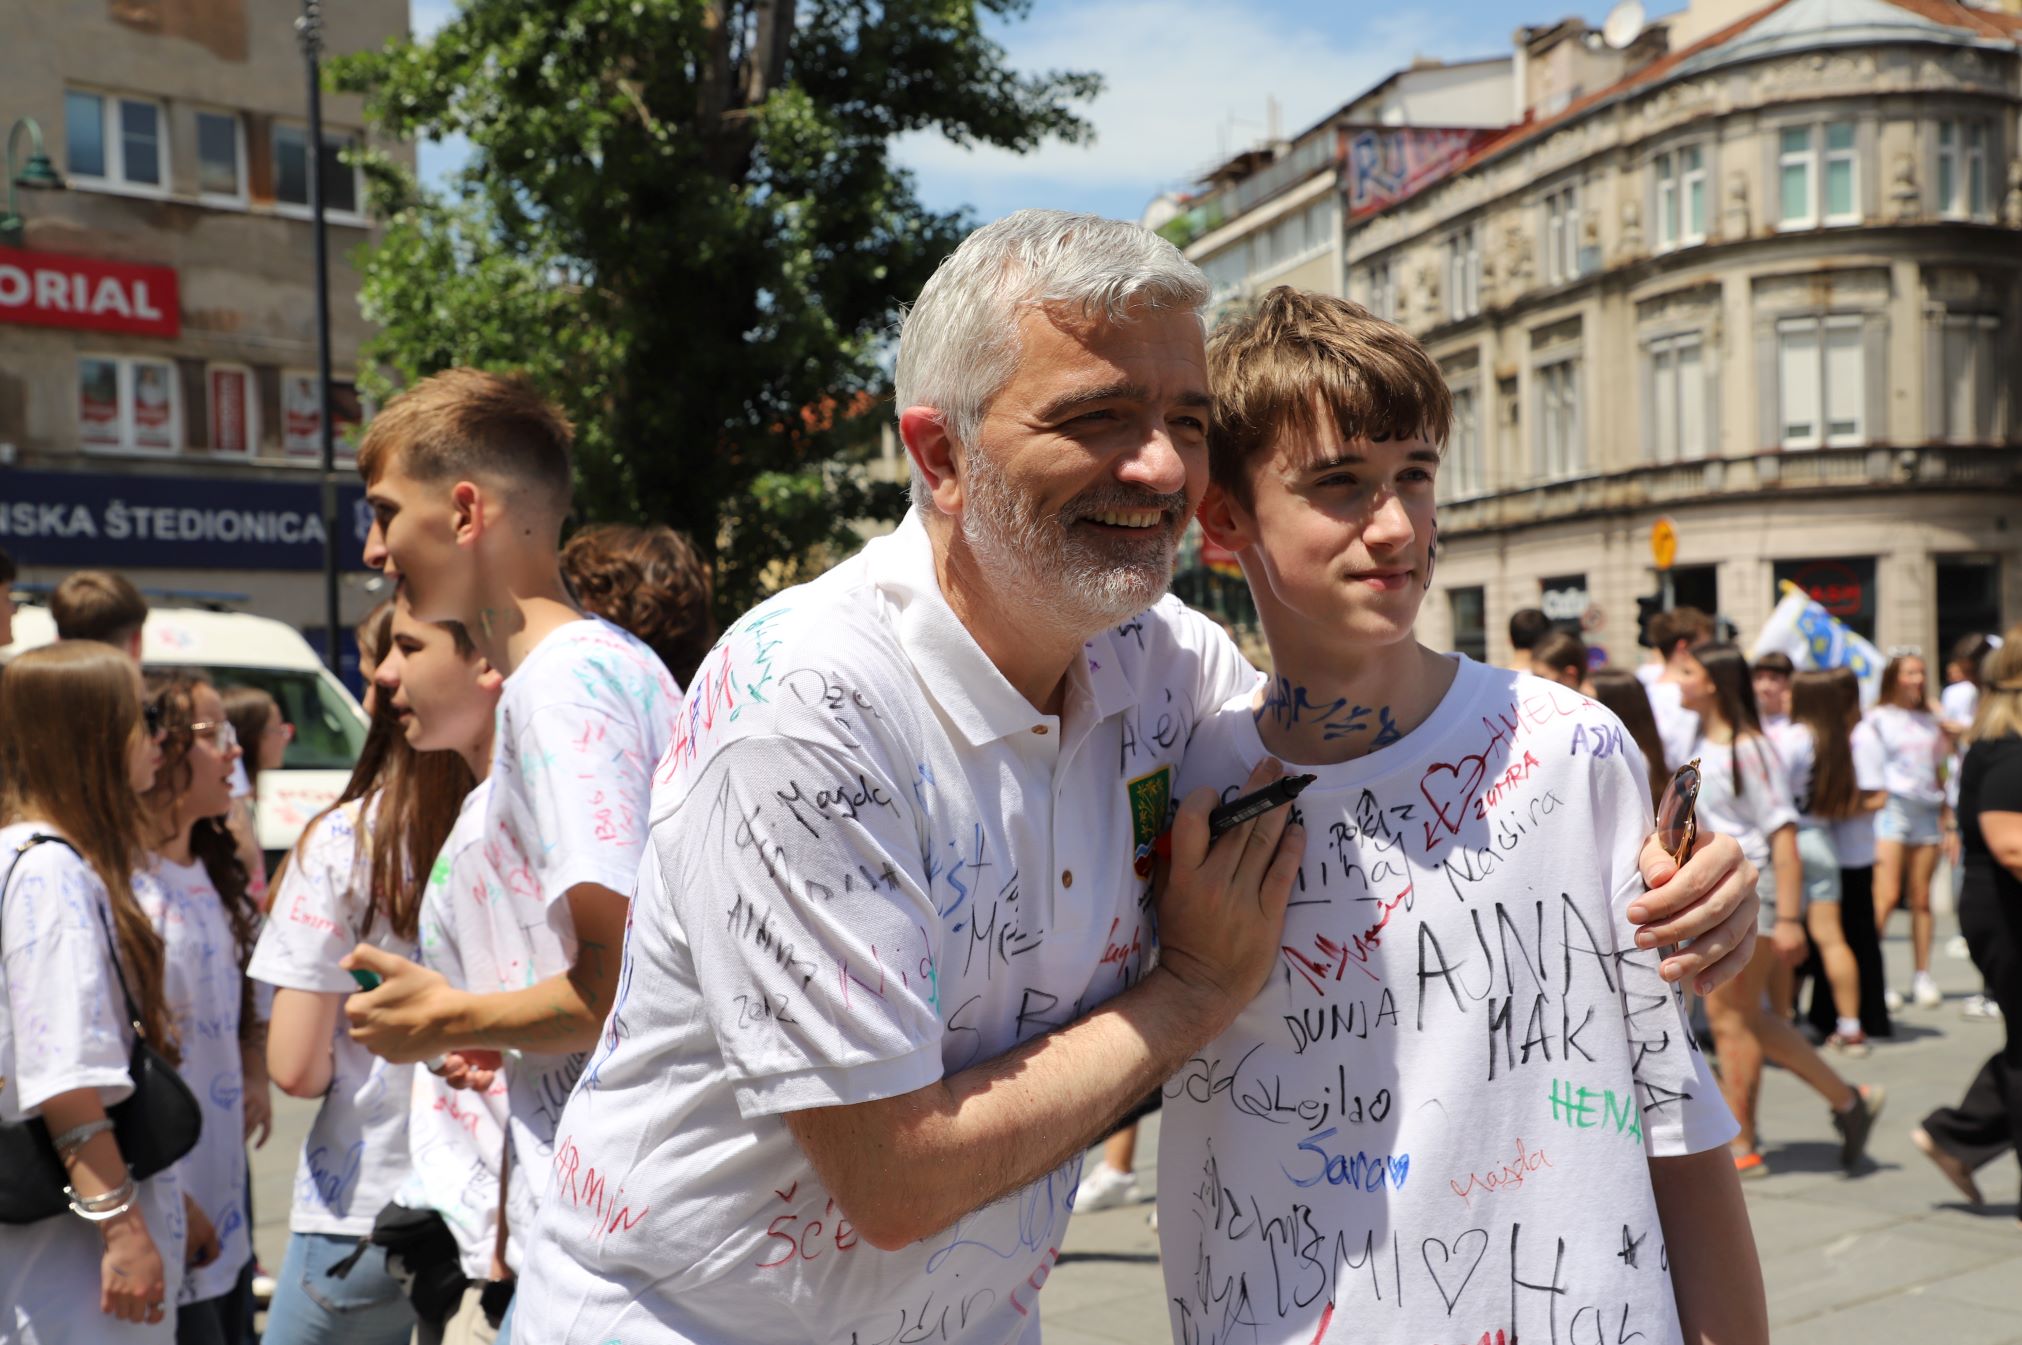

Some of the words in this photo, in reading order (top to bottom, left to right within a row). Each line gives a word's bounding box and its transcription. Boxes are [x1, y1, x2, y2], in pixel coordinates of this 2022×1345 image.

[0, 264, 163, 321] ORIAL
[104, 500, 327, 543] ŠTEDIONICA
[1284, 987, 1401, 1055] DUNJA
[1279, 1127, 1386, 1192] Sara
